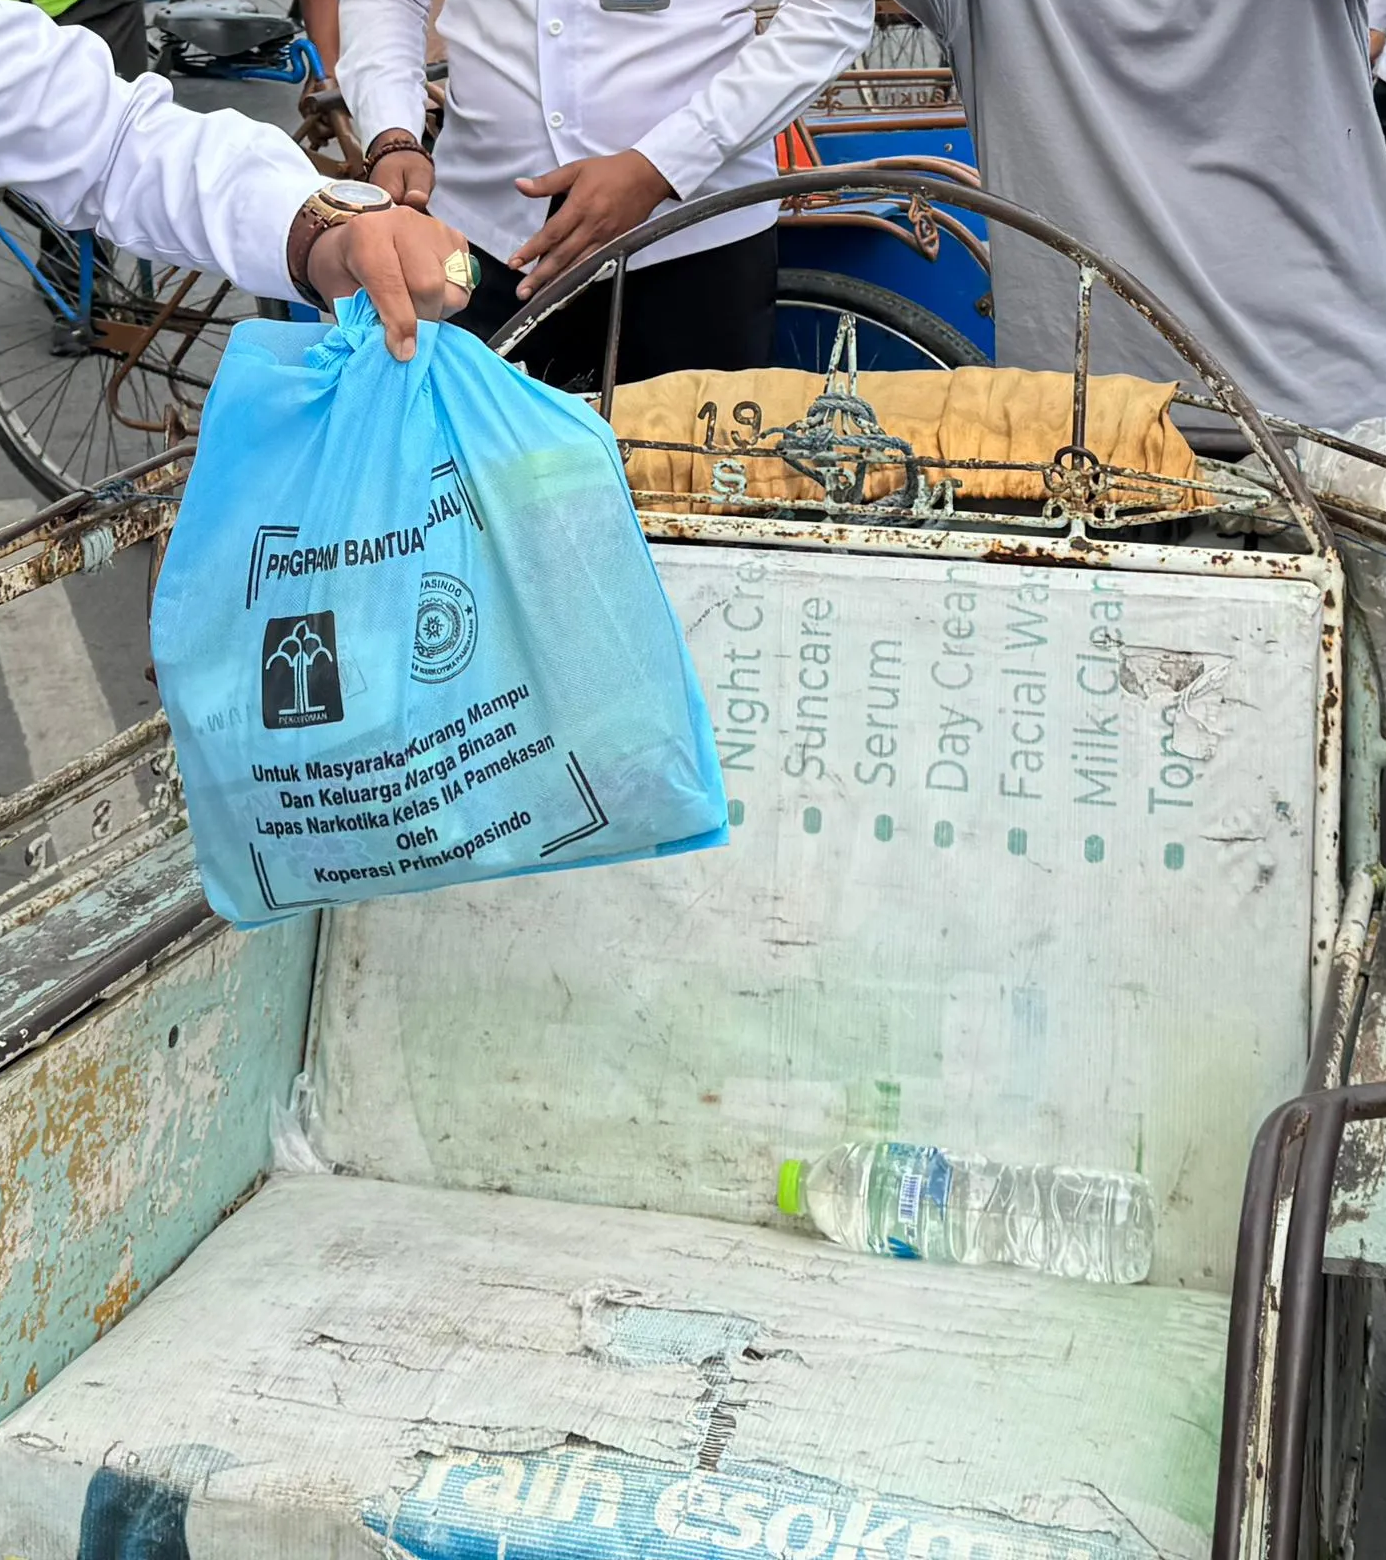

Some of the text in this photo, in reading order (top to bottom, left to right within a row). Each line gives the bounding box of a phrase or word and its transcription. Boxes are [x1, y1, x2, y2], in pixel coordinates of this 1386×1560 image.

[697, 400, 763, 447] 19
[344, 525, 428, 567] BANTUA
[251, 763, 300, 782] Untuk
[408, 716, 467, 759] Kurang
[467, 683, 531, 725] Mampu
[715, 647, 770, 773] Night
[784, 595, 834, 780] Suncare
[854, 639, 903, 788] Serum
[998, 667, 1047, 800] Facial
[256, 733, 556, 839] Lapas Narkotika Kelas IIA Pamekasan
[280, 790, 314, 809] Dan
[319, 780, 402, 808] Keluarga
[459, 721, 518, 760] Binaan
[925, 703, 984, 792] Day
[1071, 712, 1119, 807] Milk
[314, 809, 532, 885] Koperasi Primkopasindo
[395, 826, 439, 851] Oleh
